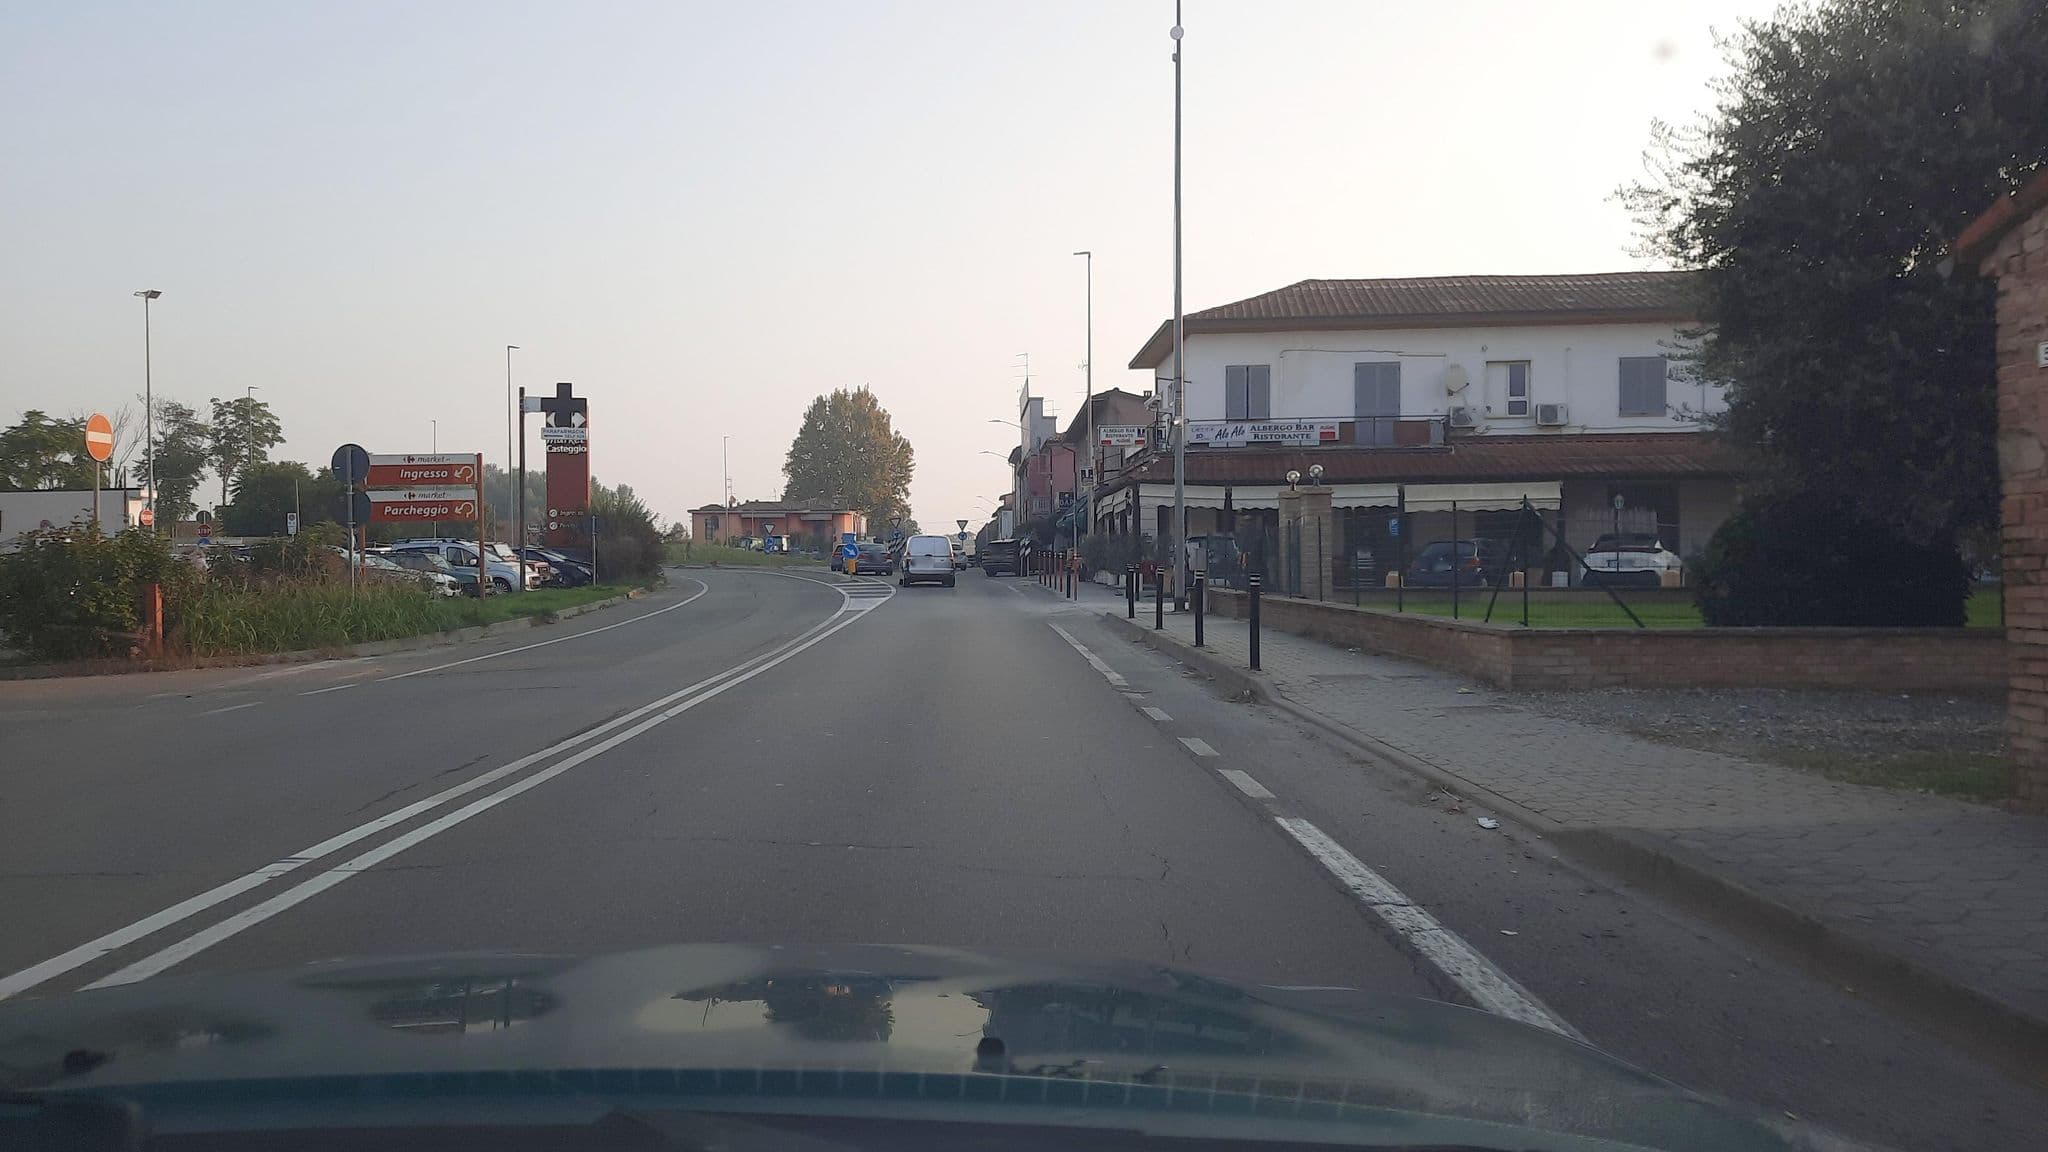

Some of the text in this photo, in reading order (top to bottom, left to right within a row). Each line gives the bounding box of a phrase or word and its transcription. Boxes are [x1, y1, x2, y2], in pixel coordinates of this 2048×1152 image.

[1250, 424, 1293, 432] ALBERGO
[1296, 423, 1315, 431] BAR
[546, 445, 587, 455] Casteggio
[400, 469, 448, 480] Ingresso
[384, 505, 449, 516] Parcheggio
